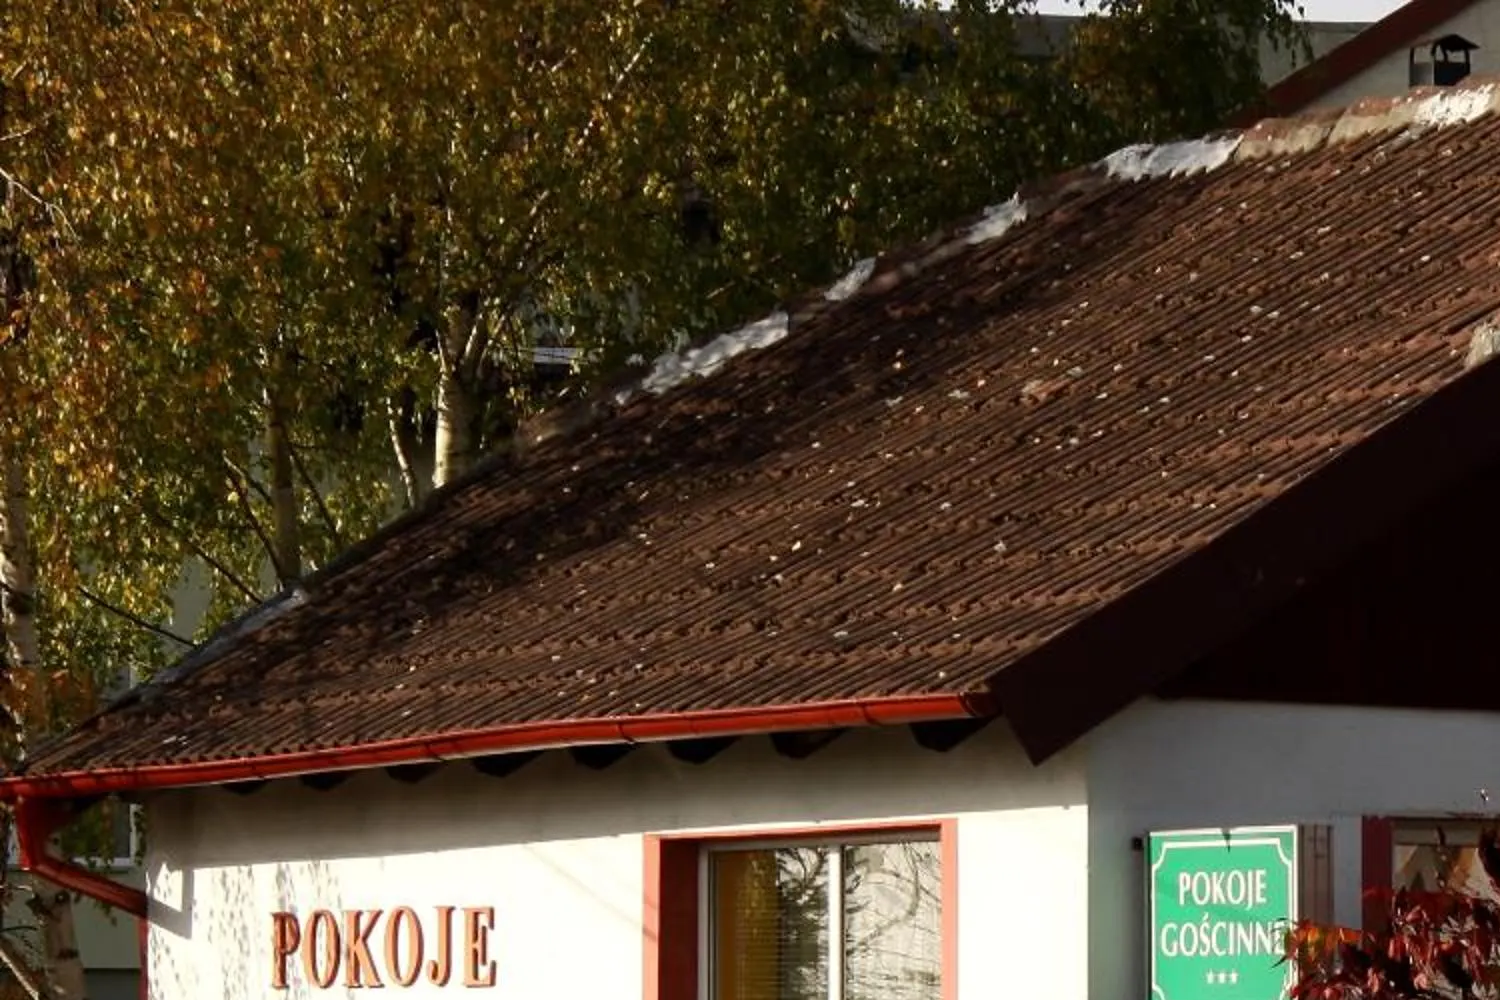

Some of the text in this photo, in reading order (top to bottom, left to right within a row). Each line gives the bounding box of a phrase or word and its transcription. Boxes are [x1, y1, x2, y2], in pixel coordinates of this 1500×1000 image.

[1177, 868, 1268, 911] POKOJE
[269, 904, 498, 991] POKOJE
[1160, 910, 1287, 958] GOŚCINNE
